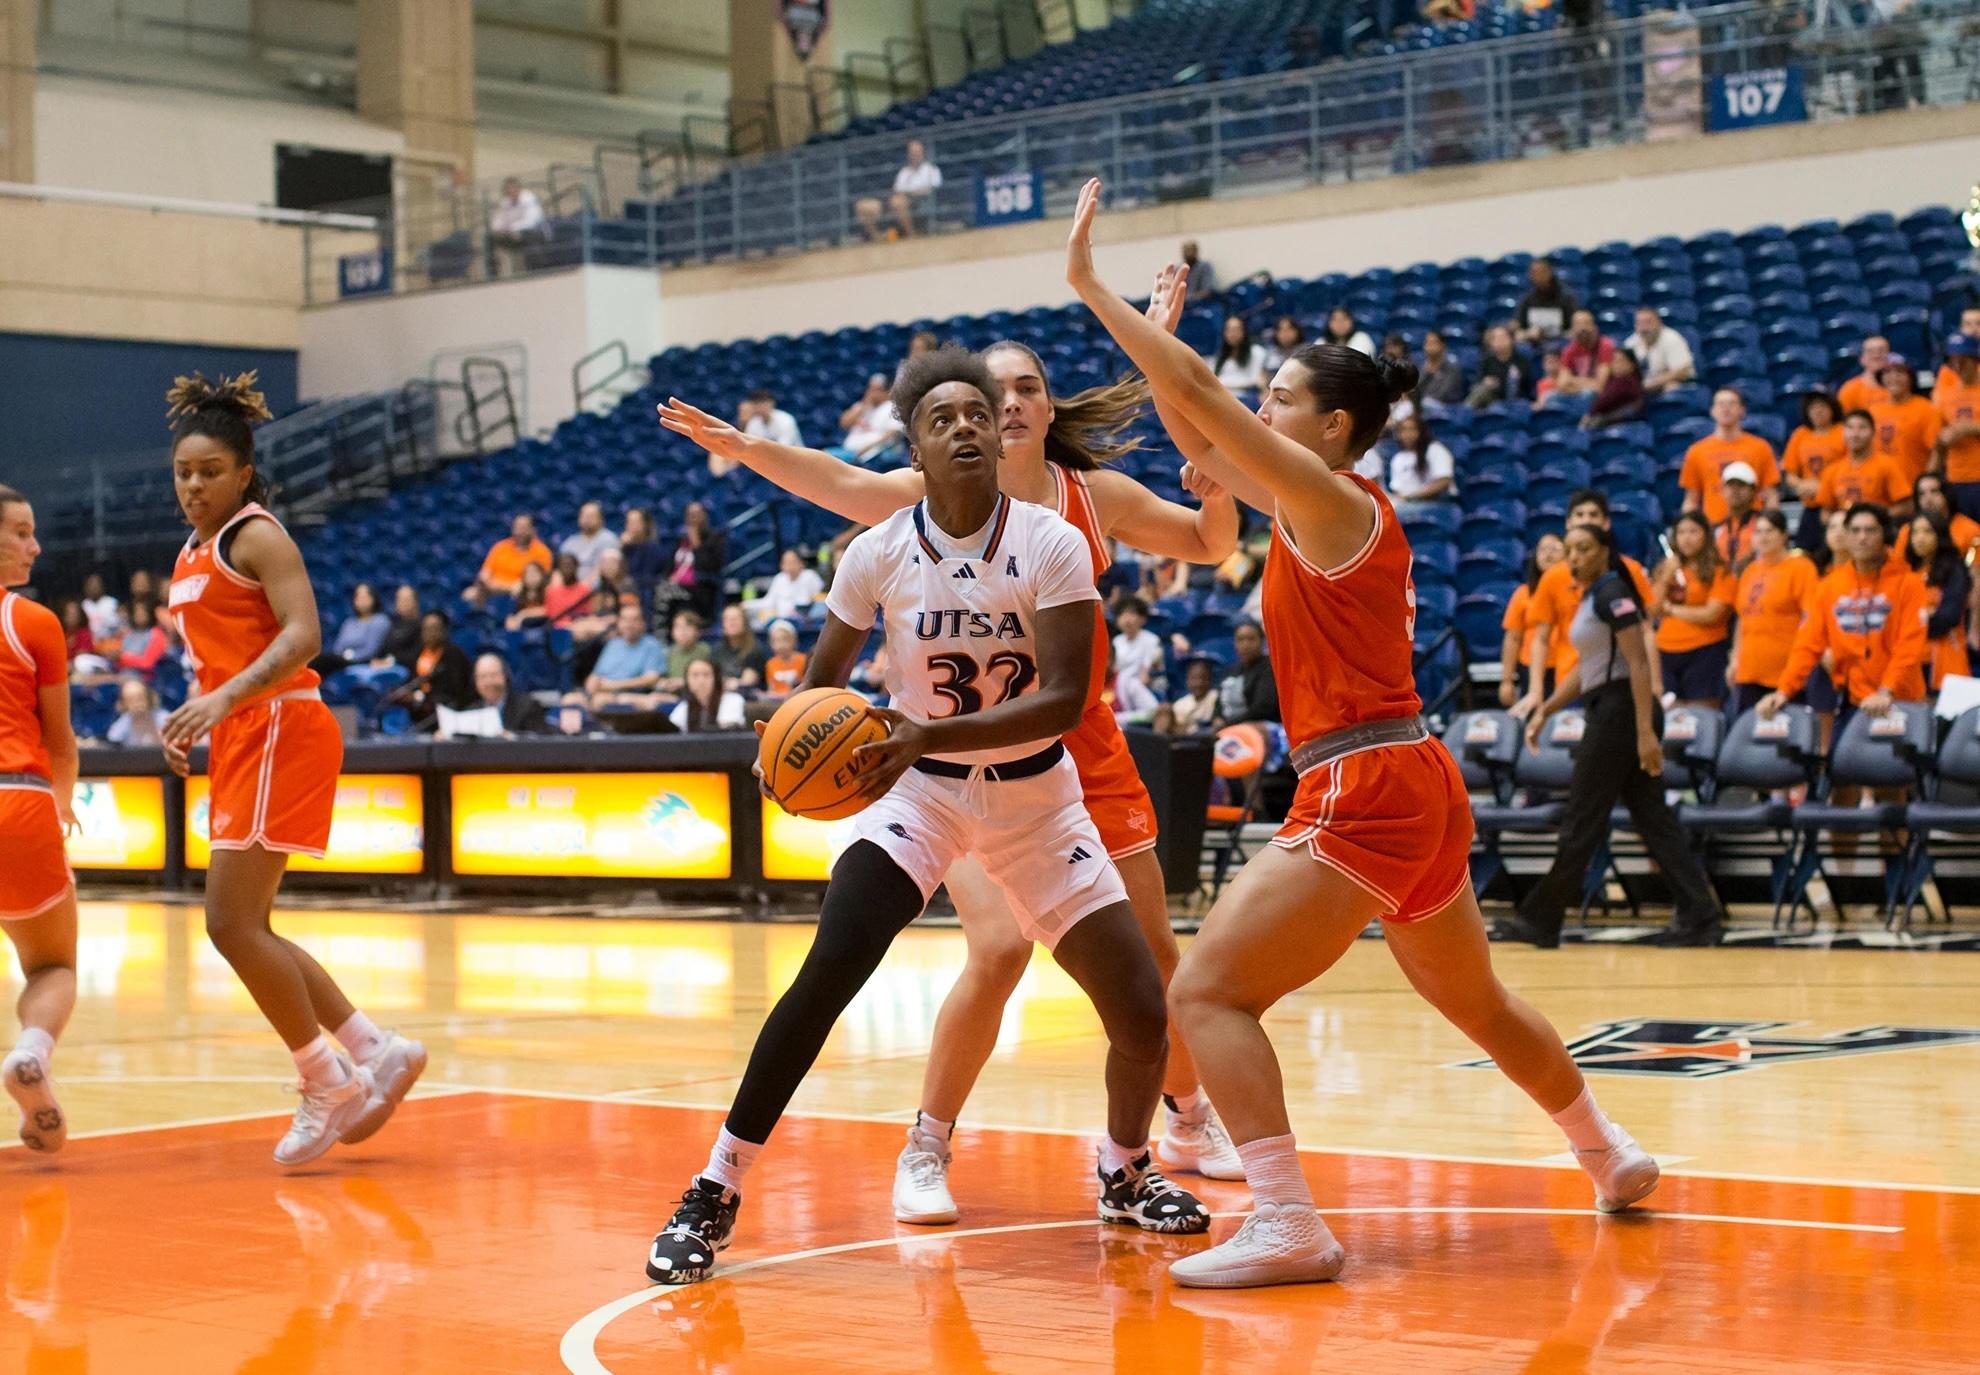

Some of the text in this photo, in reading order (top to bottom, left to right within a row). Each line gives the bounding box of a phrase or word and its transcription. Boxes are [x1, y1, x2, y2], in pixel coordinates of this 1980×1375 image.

[1726, 82, 1786, 117] 107
[915, 609, 1026, 641] UTSA
[927, 650, 1037, 720] 32
[783, 705, 858, 770] Wilson
